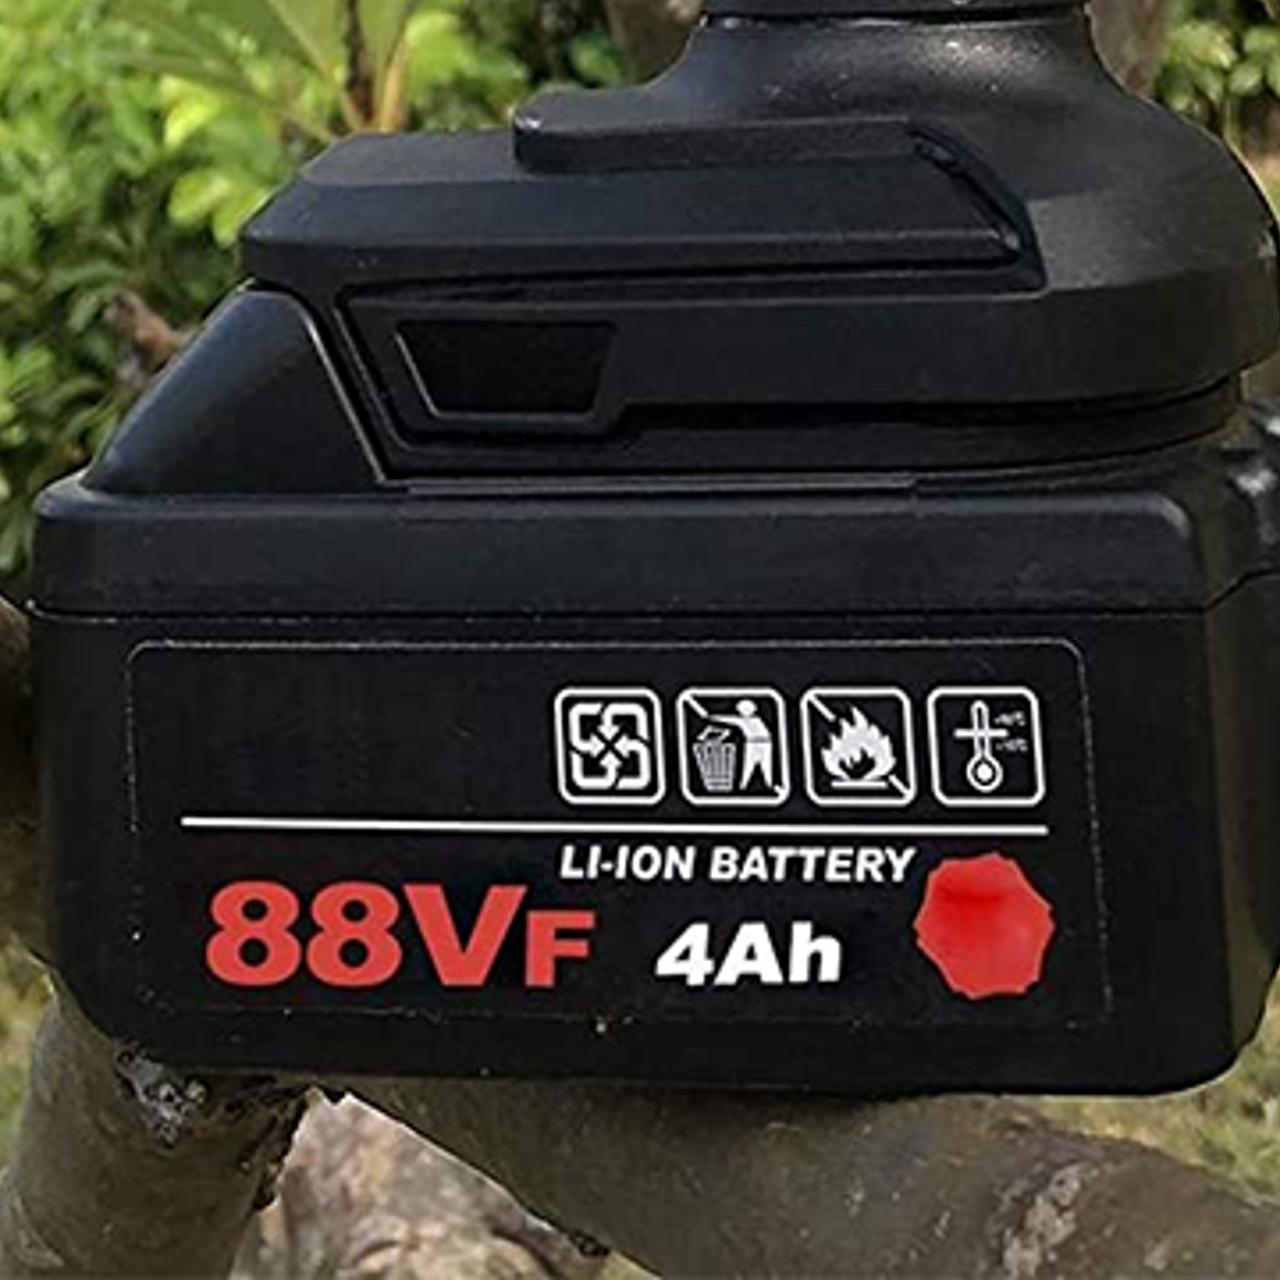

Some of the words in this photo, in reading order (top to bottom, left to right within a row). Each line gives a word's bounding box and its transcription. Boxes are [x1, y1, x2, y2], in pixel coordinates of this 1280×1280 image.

[560, 844, 697, 882] LI-ION
[709, 845, 917, 884] BATTERY
[655, 921, 842, 987] 4Ah
